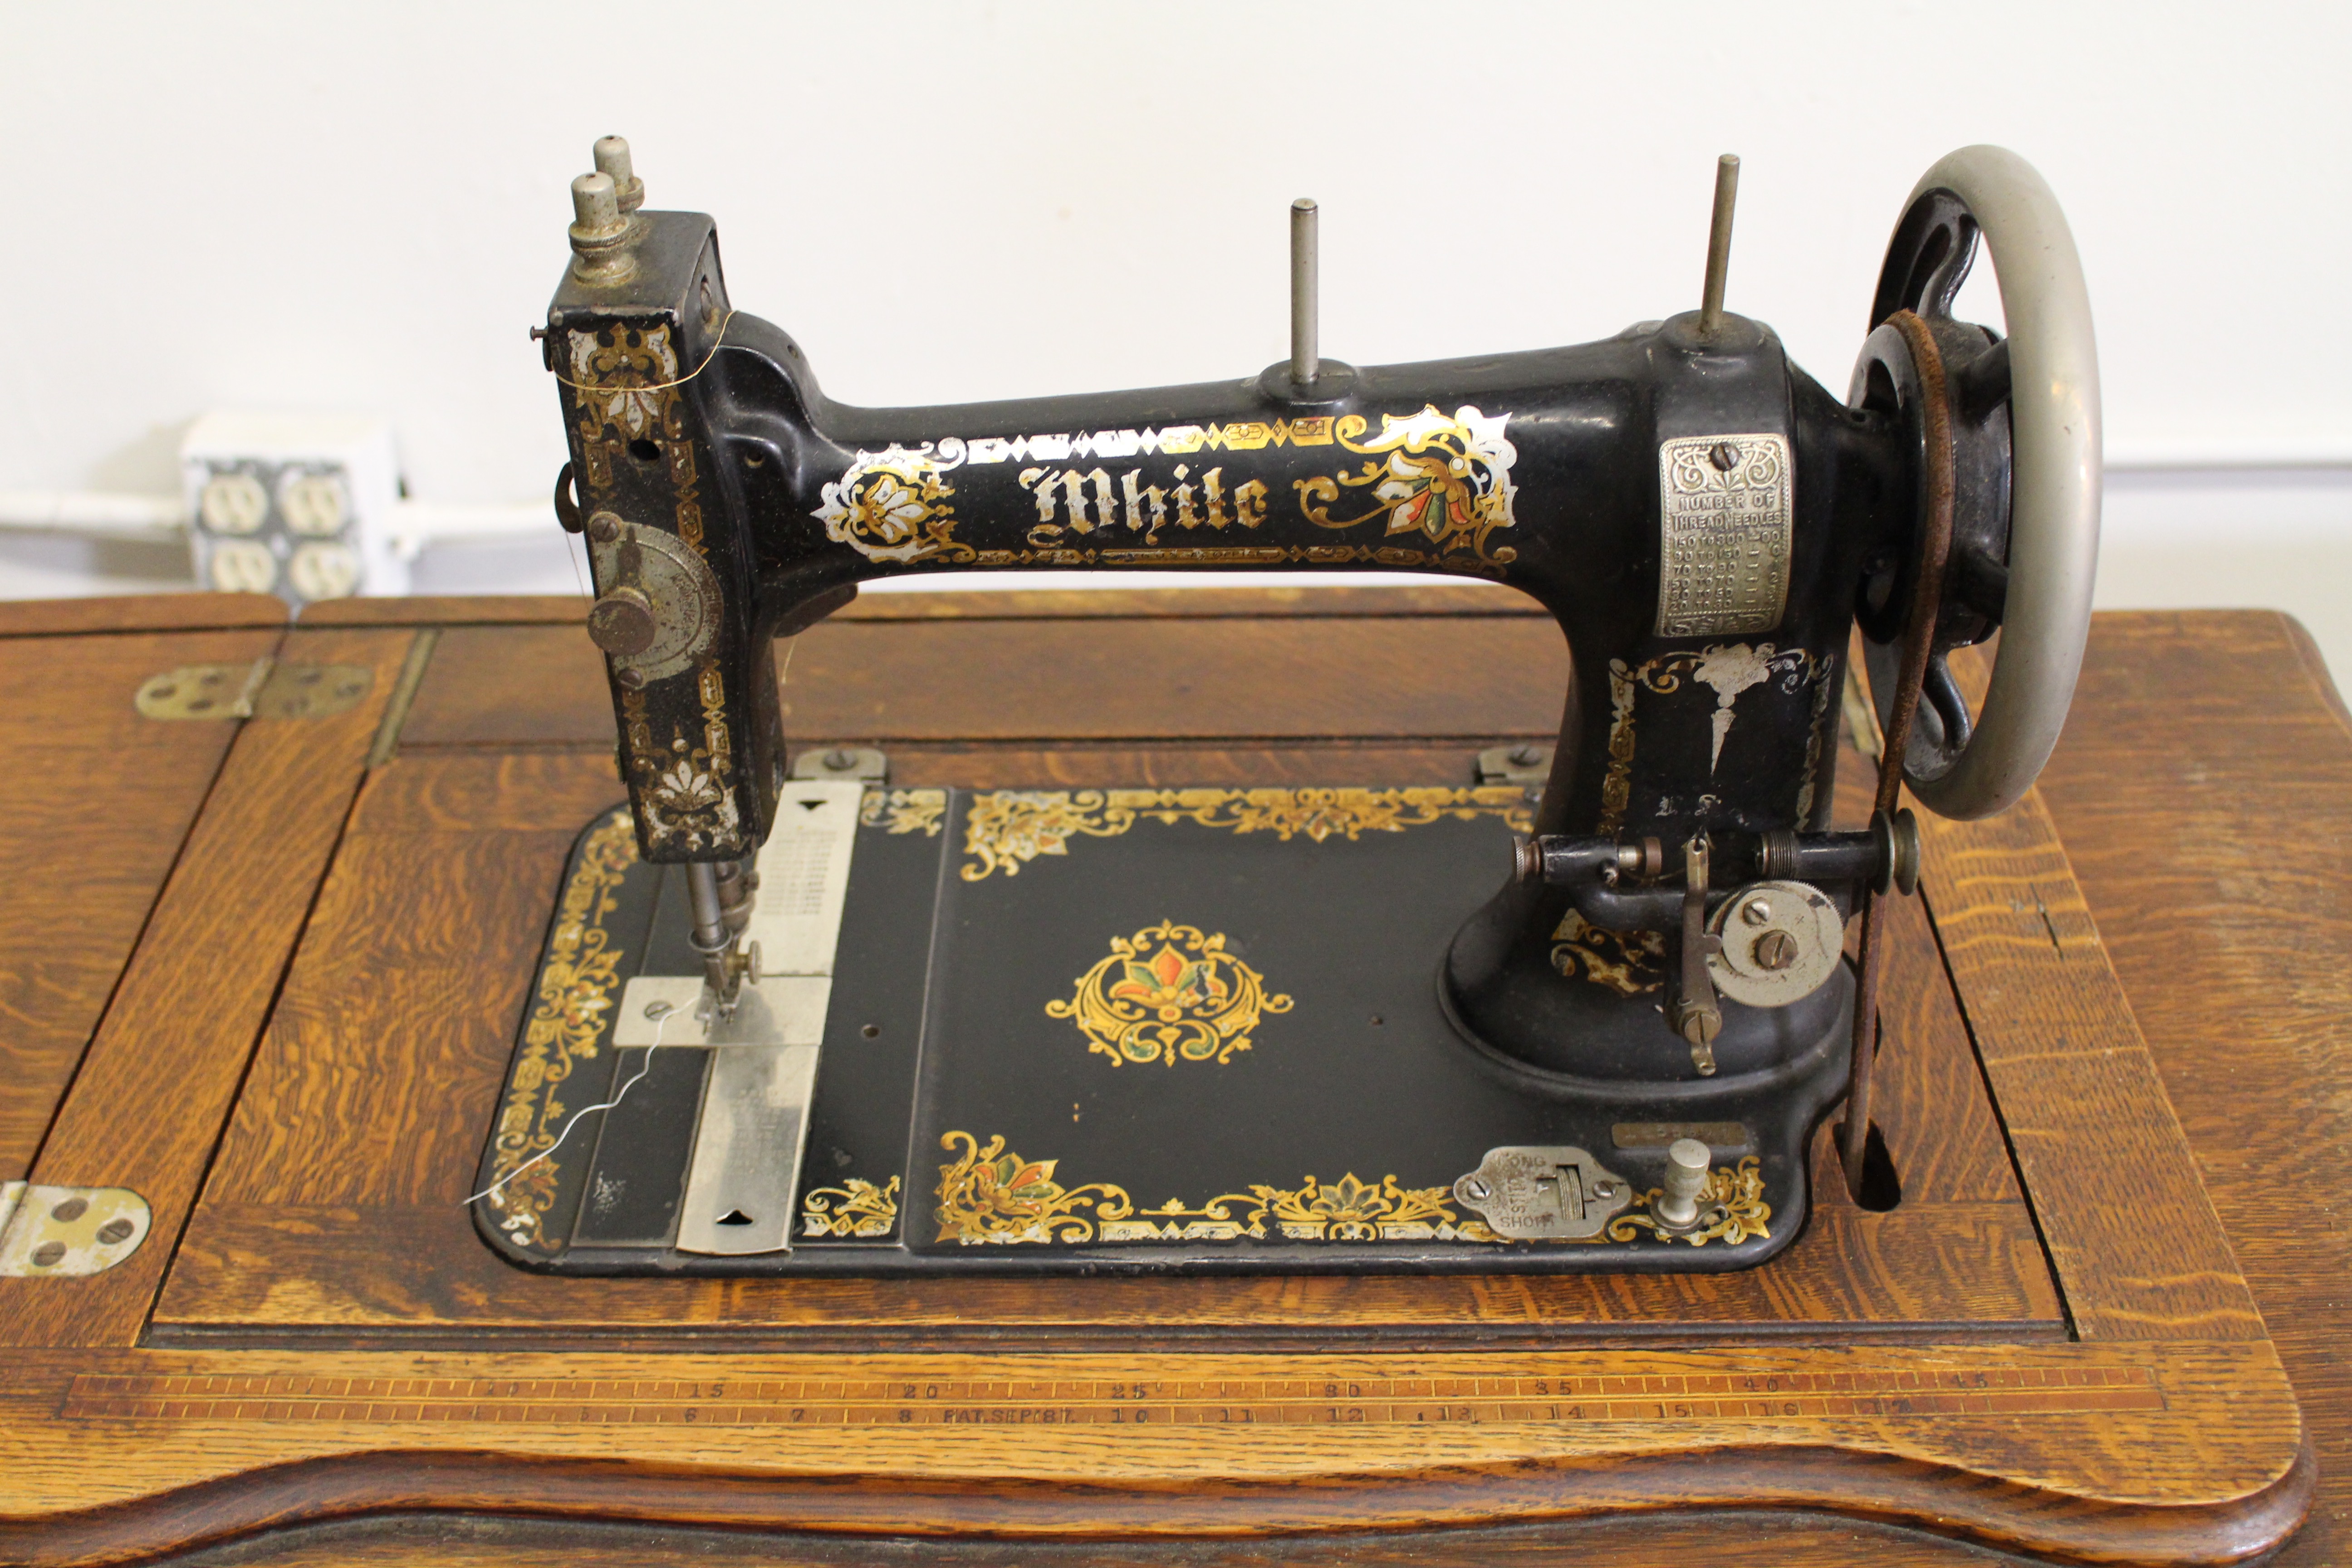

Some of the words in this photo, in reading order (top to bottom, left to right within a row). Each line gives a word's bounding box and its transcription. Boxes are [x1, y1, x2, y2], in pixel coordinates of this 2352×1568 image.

[1019, 463, 1269, 547] White
[1680, 495, 1744, 510] NUMBER
[1753, 493, 1776, 507] OF
[1672, 512, 1724, 532] THREAD
[1725, 511, 1782, 529] NEEDLES
[1674, 534, 1696, 548] 150
[1701, 536, 1715, 545] TO
[1761, 530, 1780, 543] 00
[1674, 550, 1693, 562] 90
[1698, 550, 1714, 559] TO
[1674, 564, 1692, 575] 70
[1698, 564, 1714, 573] TO
[1718, 562, 1737, 573] 90
[1671, 578, 1690, 589] 50
[1697, 577, 1713, 586] TO
[1715, 574, 1735, 586] 70
[1770, 571, 1779, 583] 2
[690, 1383, 725, 1398] 15
[903, 1384, 938, 1399] 20
[1112, 1384, 1147, 1399] 25
[1535, 1381, 1572, 1395] 35
[684, 1407, 697, 1423] 6
[792, 1408, 805, 1422] 7
[900, 1409, 911, 1424] 8
[1112, 1408, 1148, 1424] 10
[1220, 1408, 1251, 1423] 11
[1327, 1407, 1362, 1423] 12
[1546, 1406, 1583, 1420] 14
[1654, 1405, 1687, 1419] 15
[1759, 1402, 1798, 1417] 16
